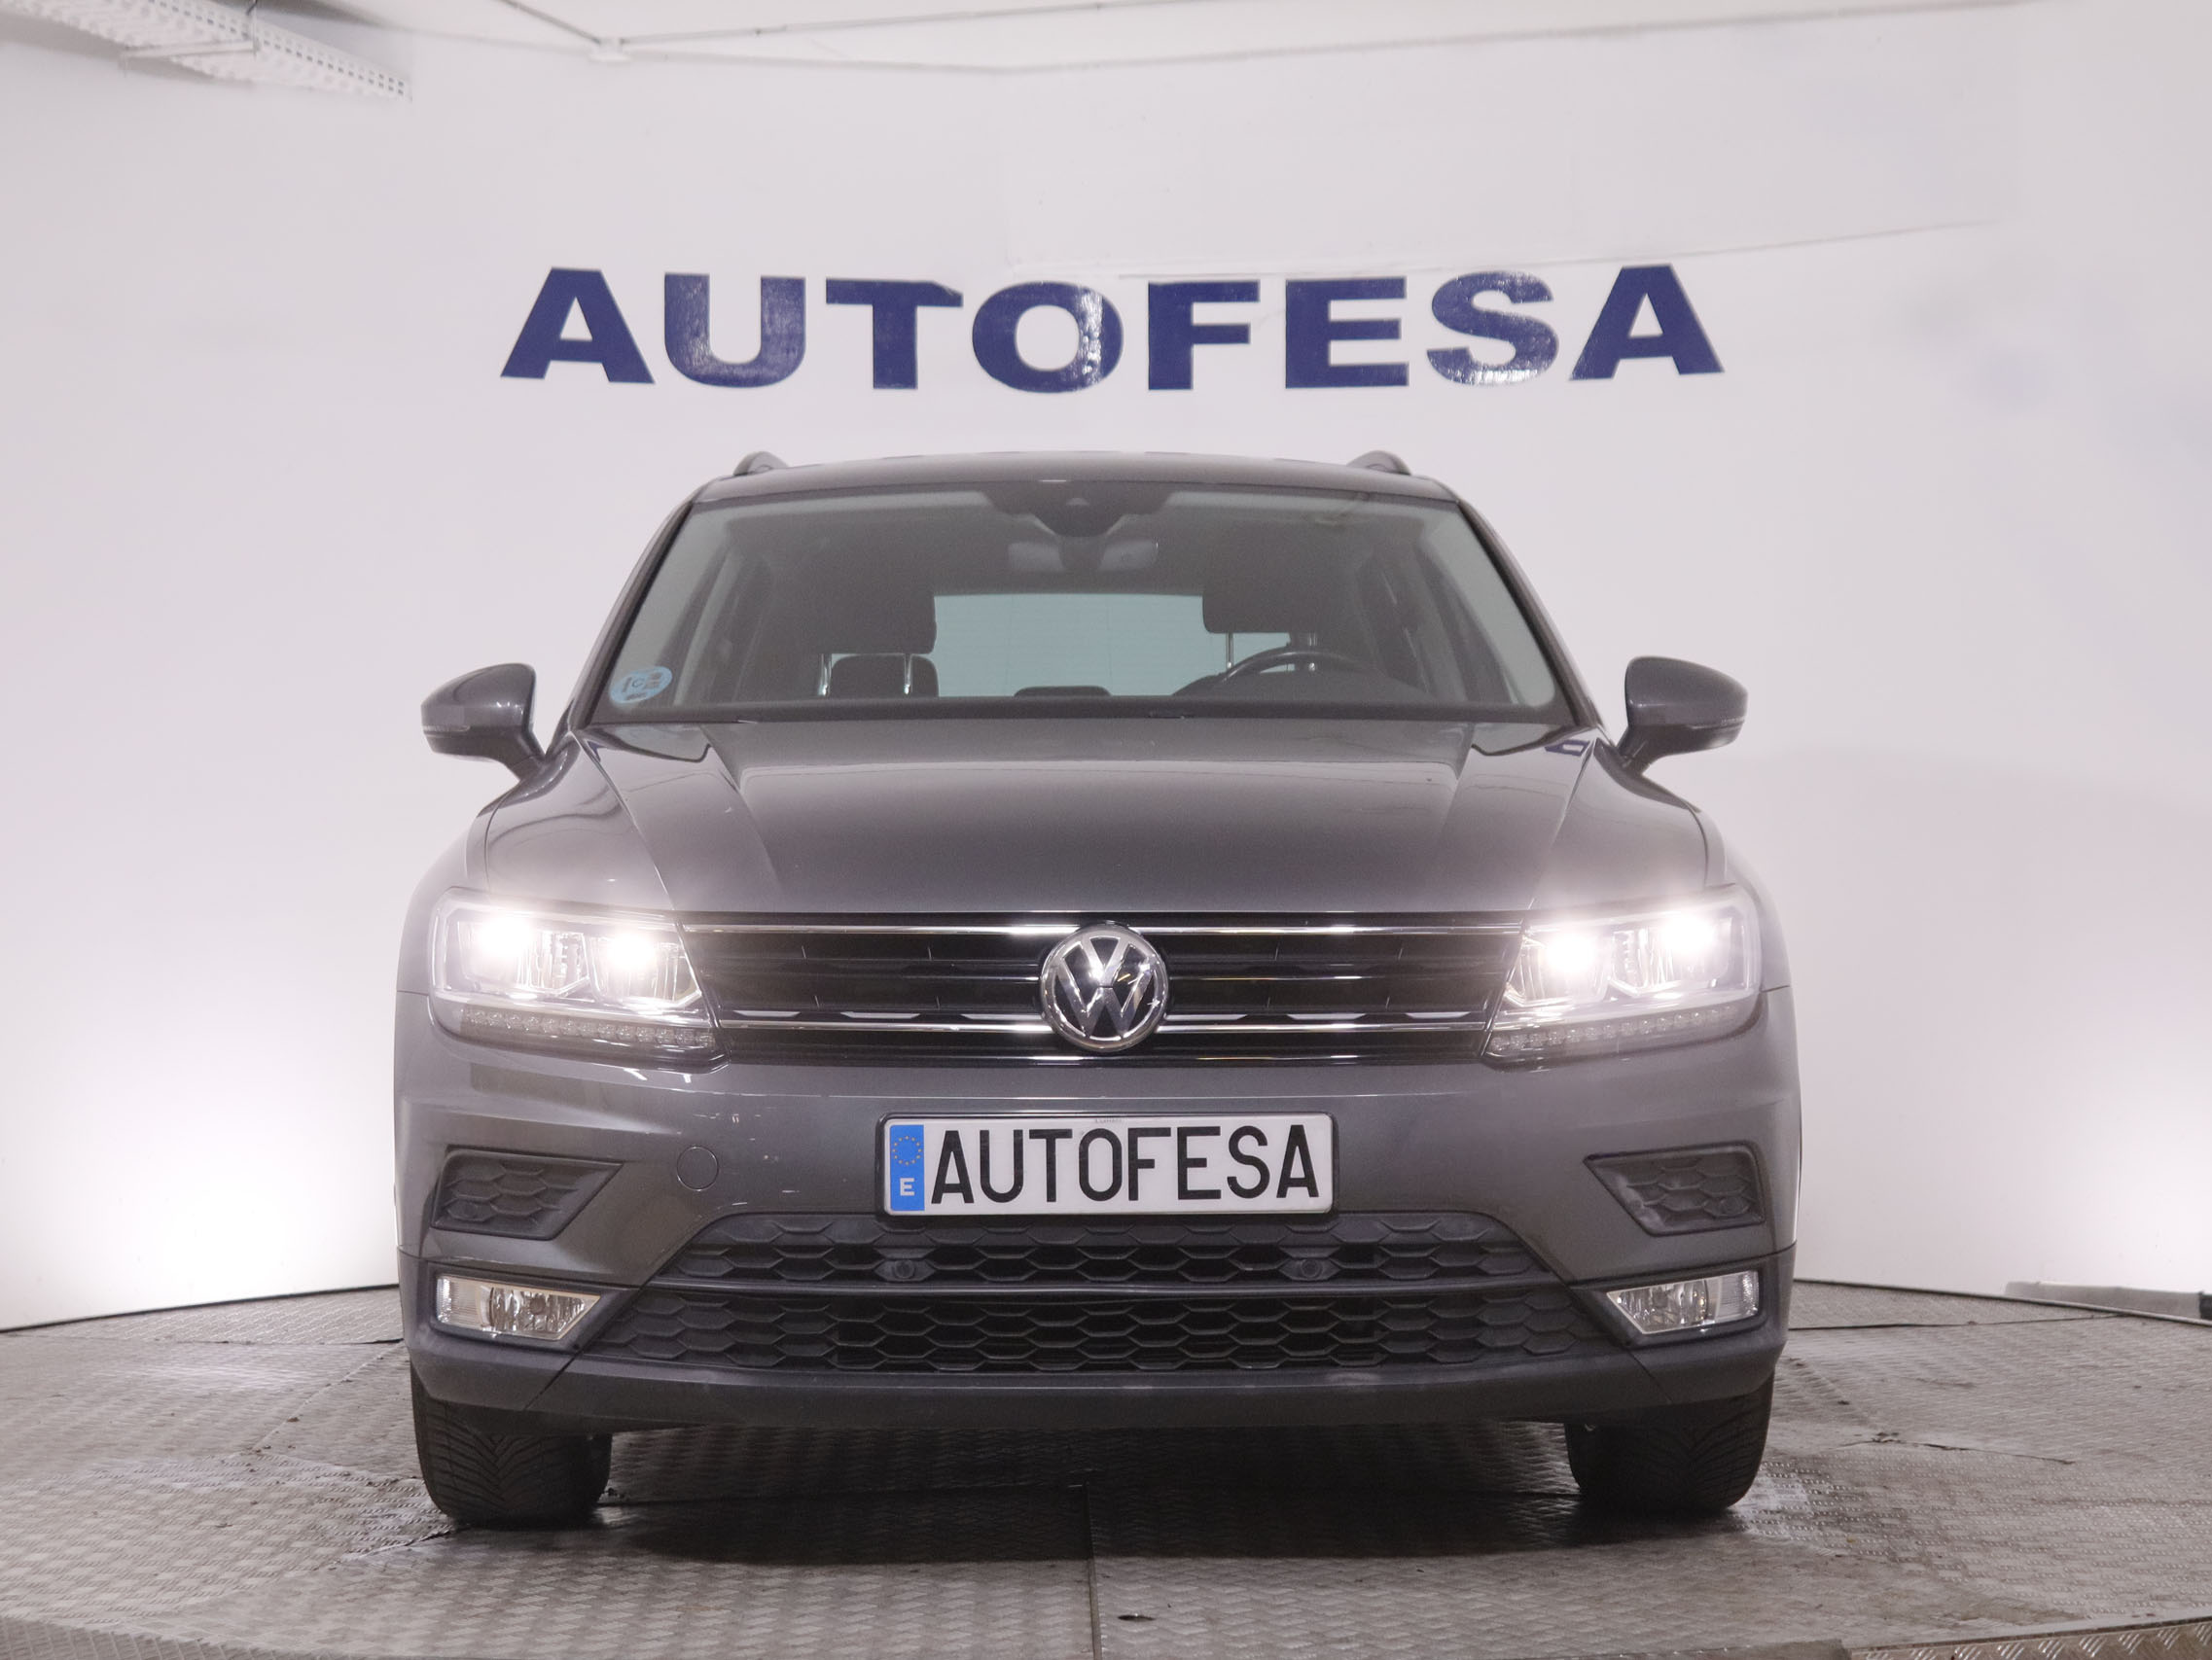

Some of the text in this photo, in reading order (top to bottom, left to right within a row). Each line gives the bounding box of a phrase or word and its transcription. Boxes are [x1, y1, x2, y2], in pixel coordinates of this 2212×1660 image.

[500, 265, 1724, 394] AUTOFESA
[1051, 929, 1159, 1042] VW
[899, 1178, 915, 1196] E
[930, 1124, 1320, 1205] AUTOFESA
